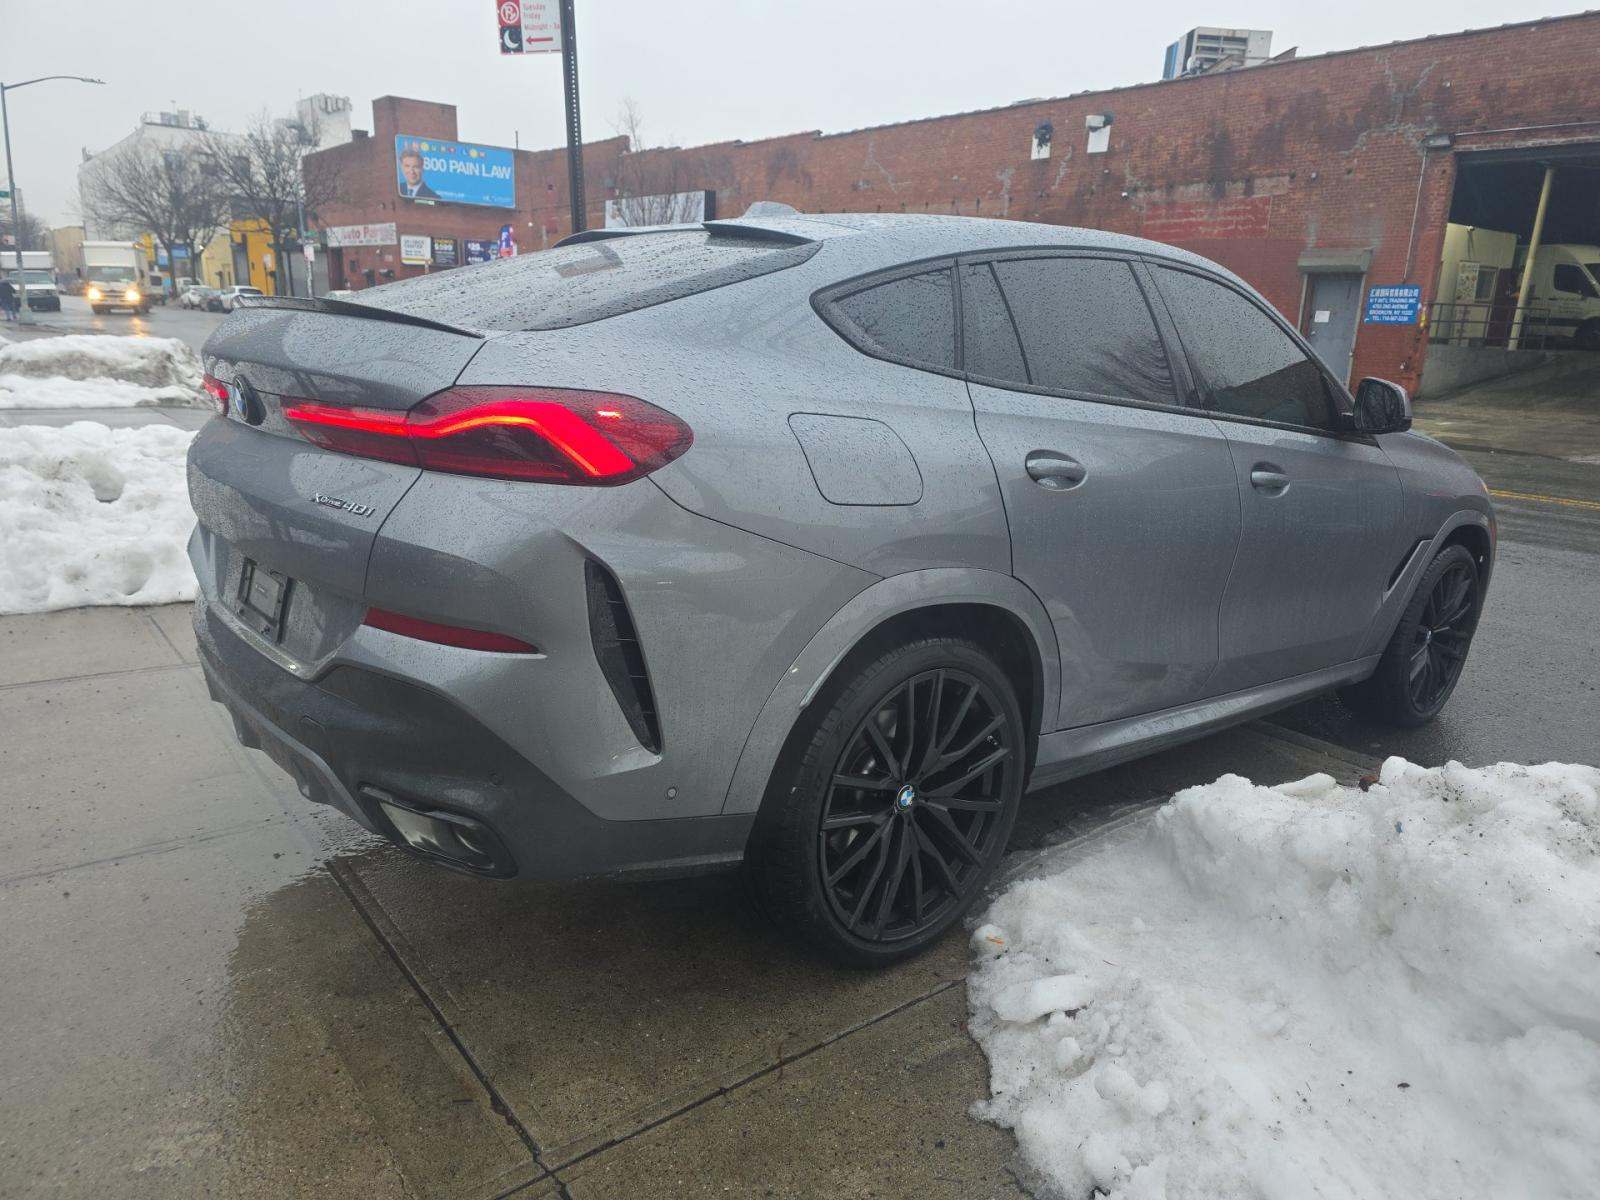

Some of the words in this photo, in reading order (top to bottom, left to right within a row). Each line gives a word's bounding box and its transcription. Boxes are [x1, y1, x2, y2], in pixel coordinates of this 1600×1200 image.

[423, 156, 447, 173] 800
[449, 159, 480, 177] PAIN
[481, 163, 512, 180] LAW
